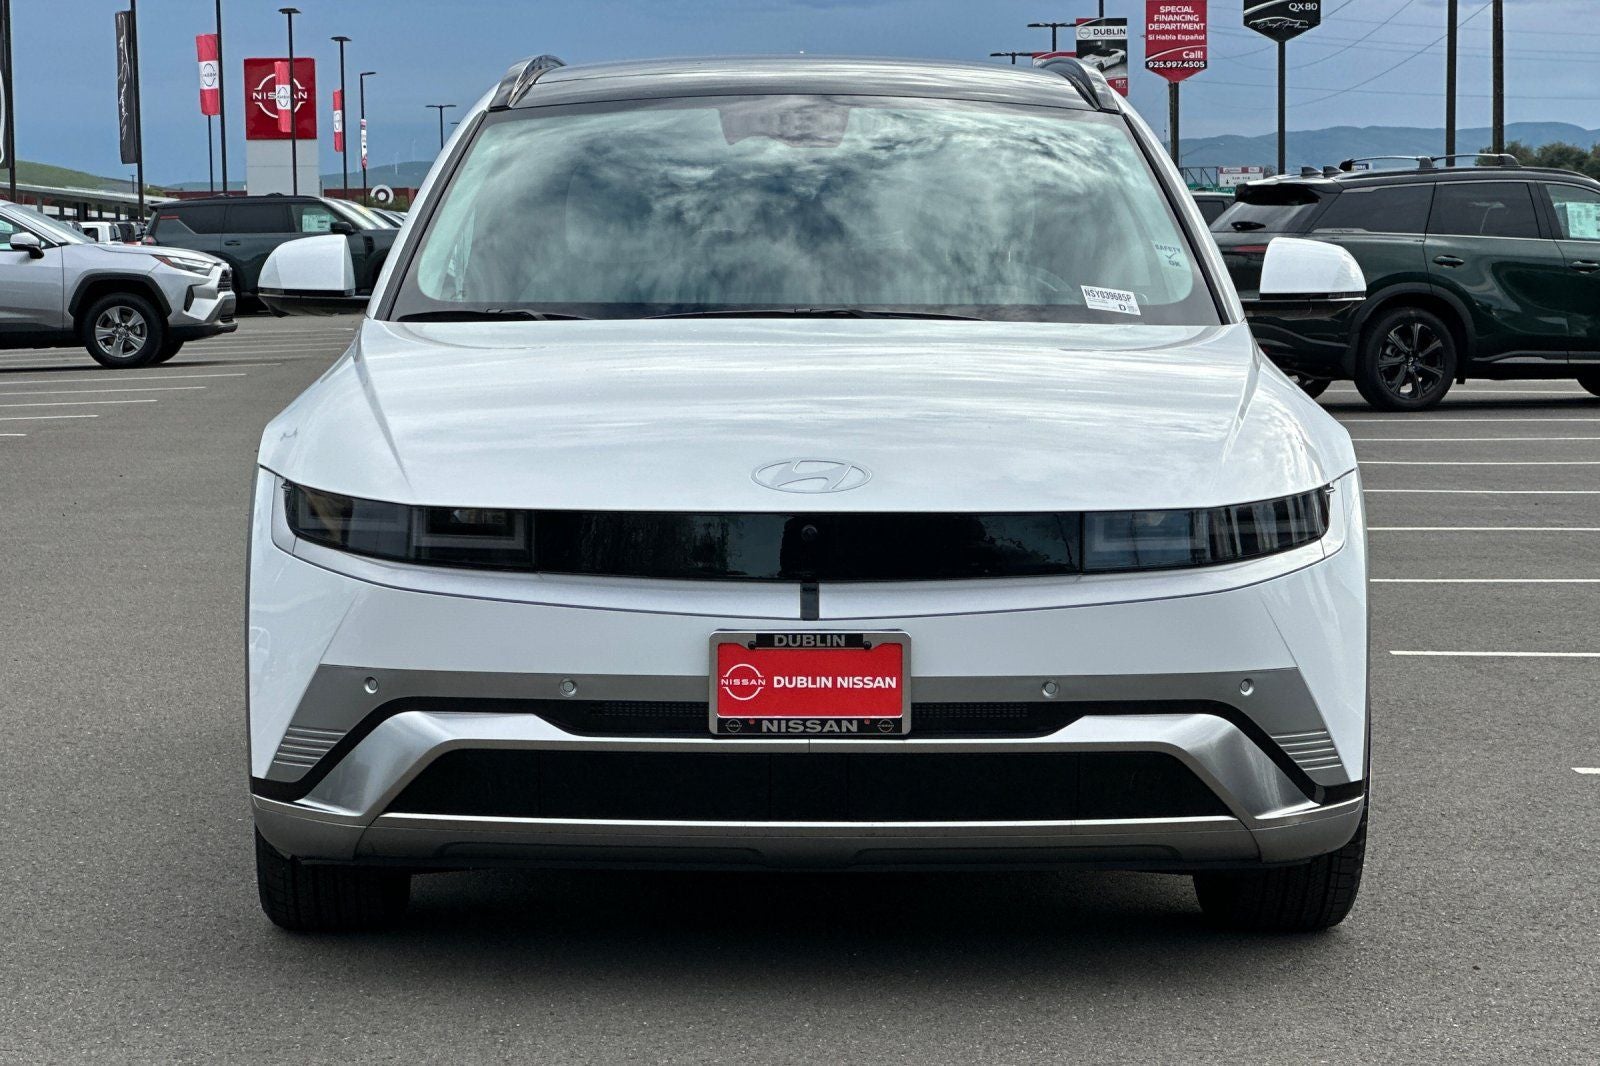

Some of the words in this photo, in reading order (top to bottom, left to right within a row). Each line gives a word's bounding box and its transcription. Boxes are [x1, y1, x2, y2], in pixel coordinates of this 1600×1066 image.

[1289, 3, 1318, 12] QX80
[1093, 28, 1126, 36] DUBLIN
[1183, 51, 1203, 59] Call!
[252, 91, 308, 100] NISN
[774, 634, 846, 647] DUBLIN
[721, 678, 766, 686] NISSAN
[773, 676, 832, 688] DUBLIN
[837, 676, 897, 688] NISSAN
[761, 719, 858, 733] NISSAN
